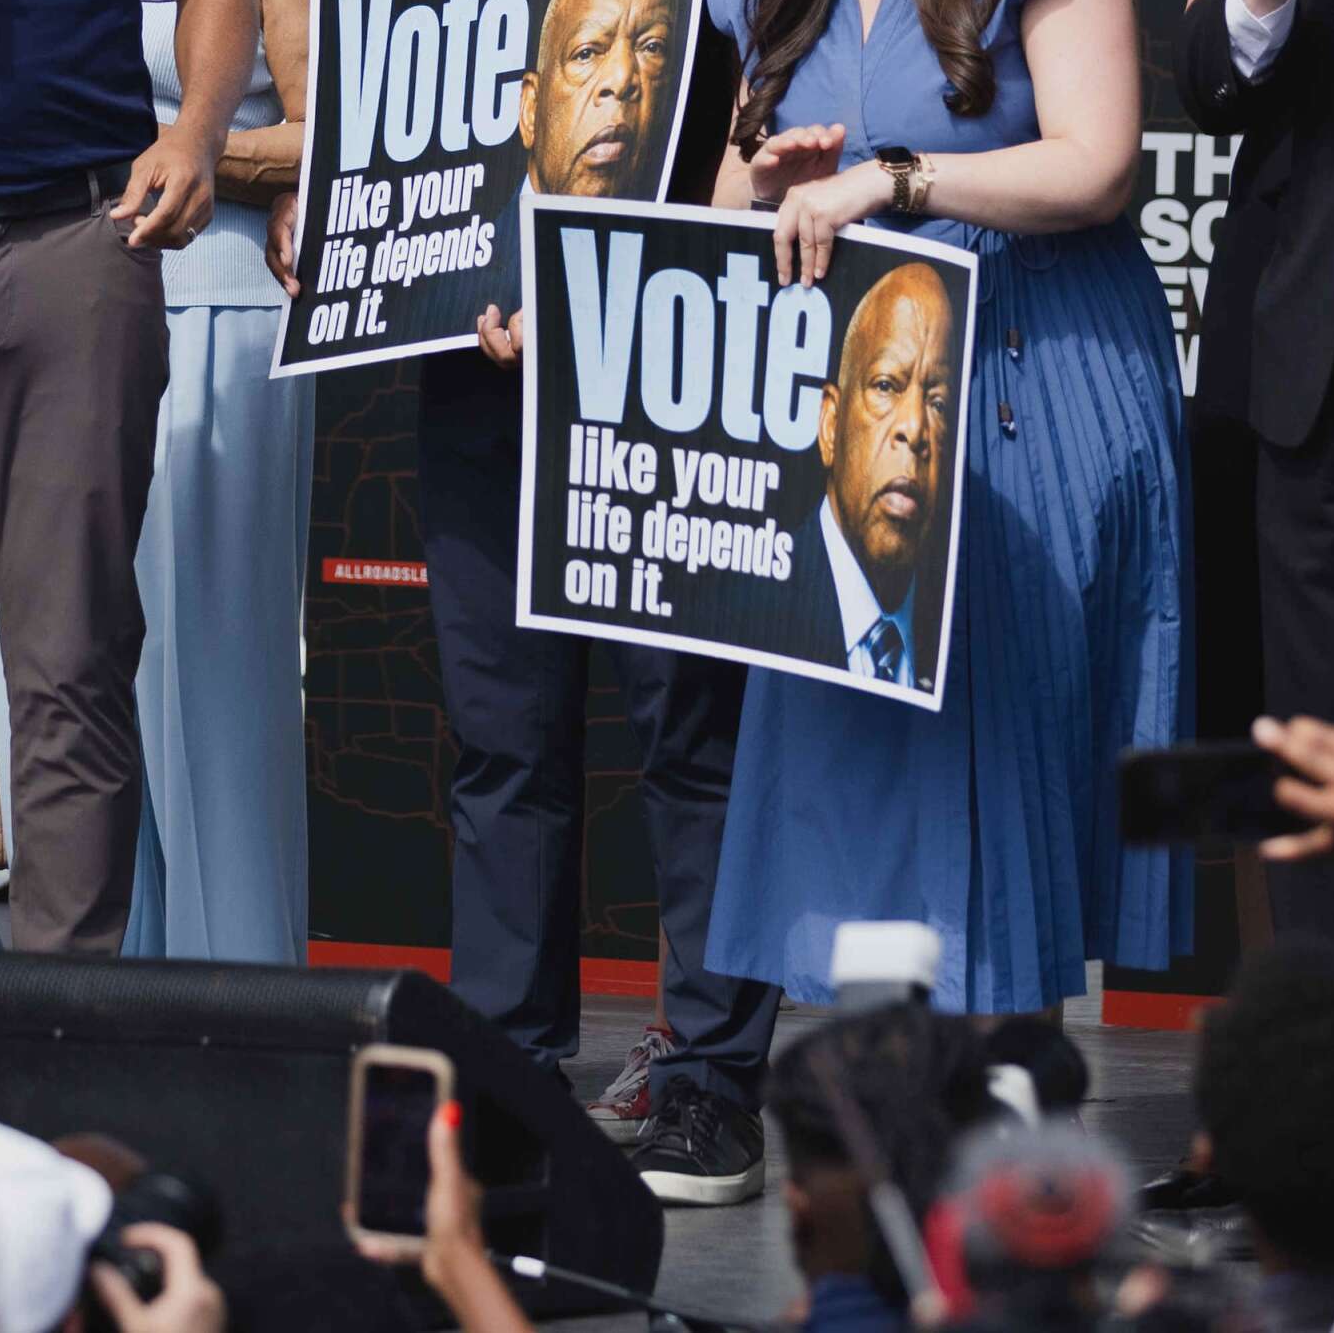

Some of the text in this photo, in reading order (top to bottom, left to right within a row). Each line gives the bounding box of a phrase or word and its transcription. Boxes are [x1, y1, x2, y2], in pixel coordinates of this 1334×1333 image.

[326, 162, 485, 236] like your
[316, 214, 495, 294] life depends
[307, 288, 387, 345] on it.
[560, 227, 832, 452] Vote
[568, 423, 780, 512] like your
[566, 489, 794, 581] life depends
[564, 558, 673, 617] on it.
